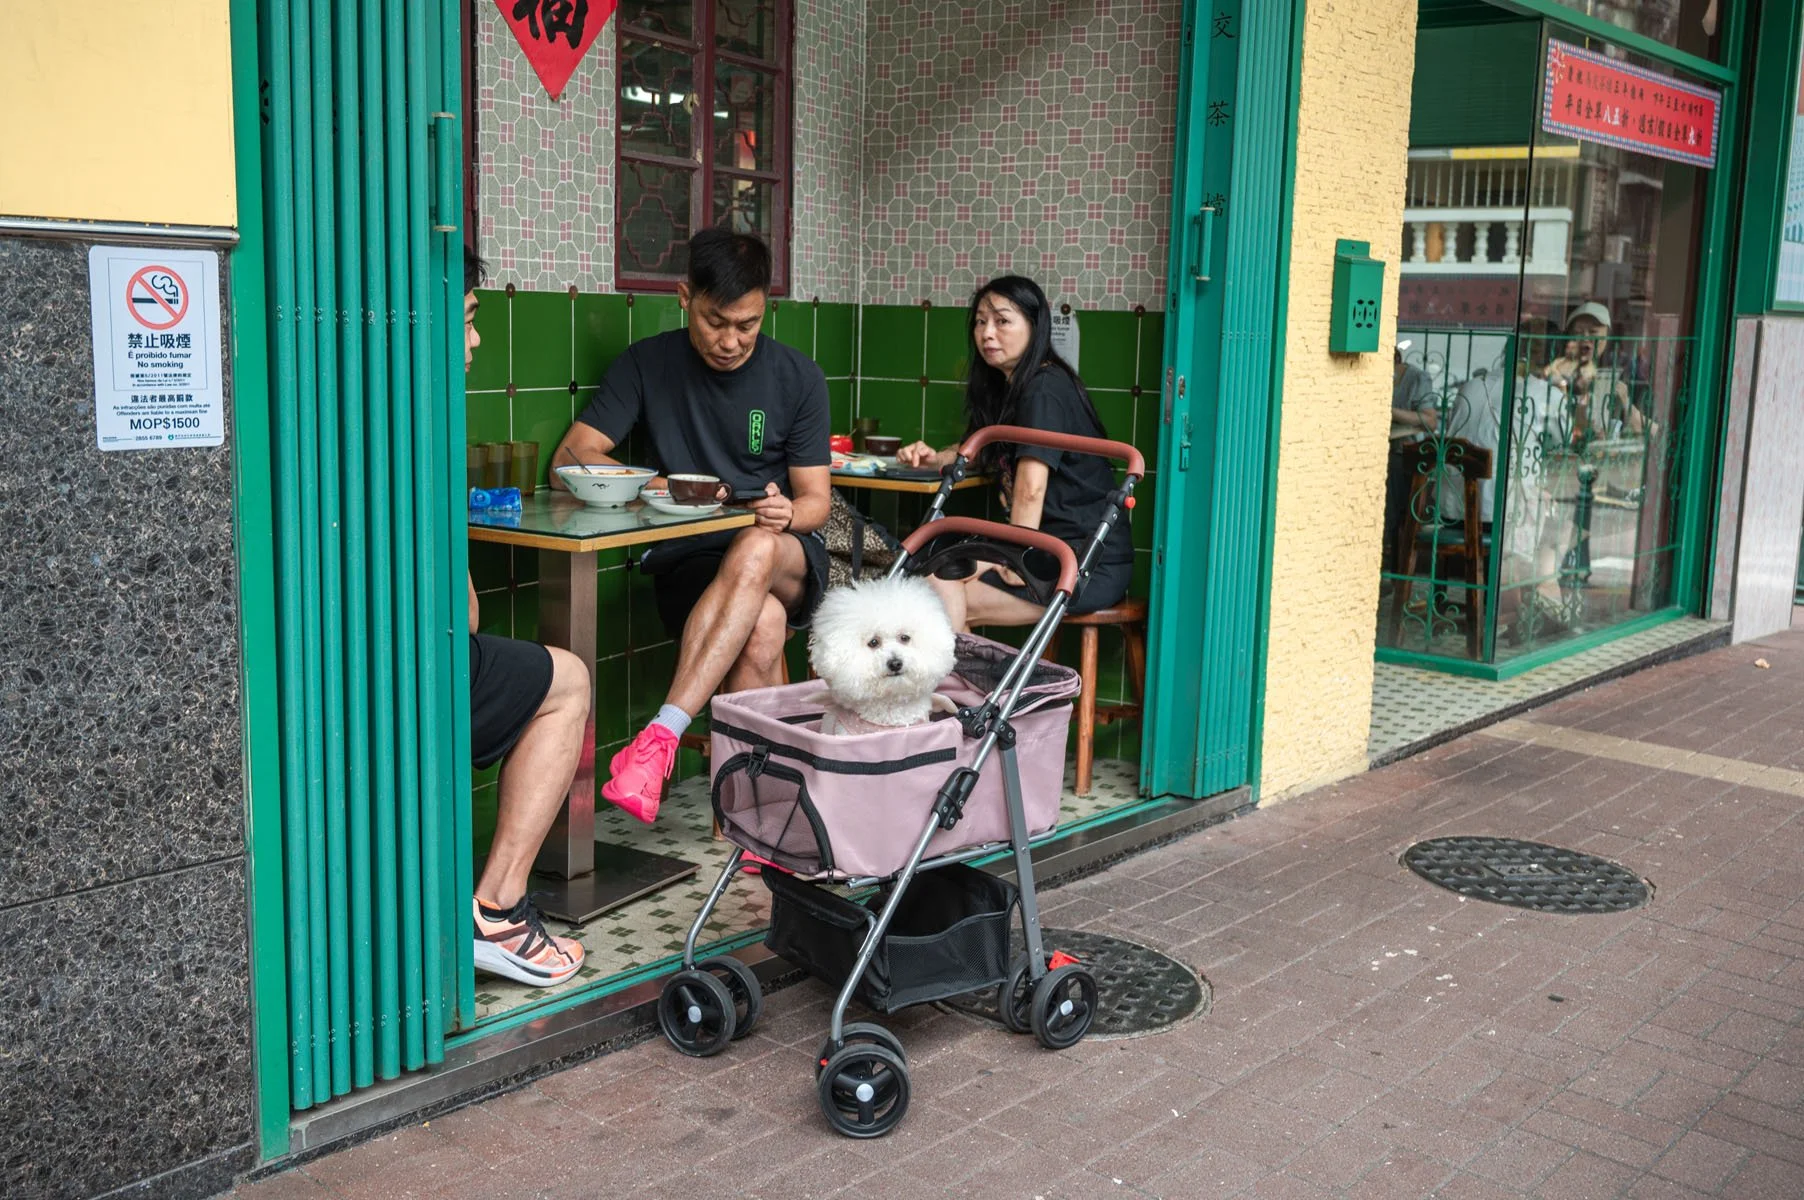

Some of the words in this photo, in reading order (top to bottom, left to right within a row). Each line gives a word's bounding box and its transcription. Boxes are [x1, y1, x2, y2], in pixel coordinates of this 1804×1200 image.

[128, 333, 191, 349] 禁止吸煙
[128, 350, 134, 359] É
[135, 351, 167, 360] proibido
[169, 351, 192, 359] fumar
[150, 361, 184, 369] smoking
[130, 417, 200, 430] MOP$1500
